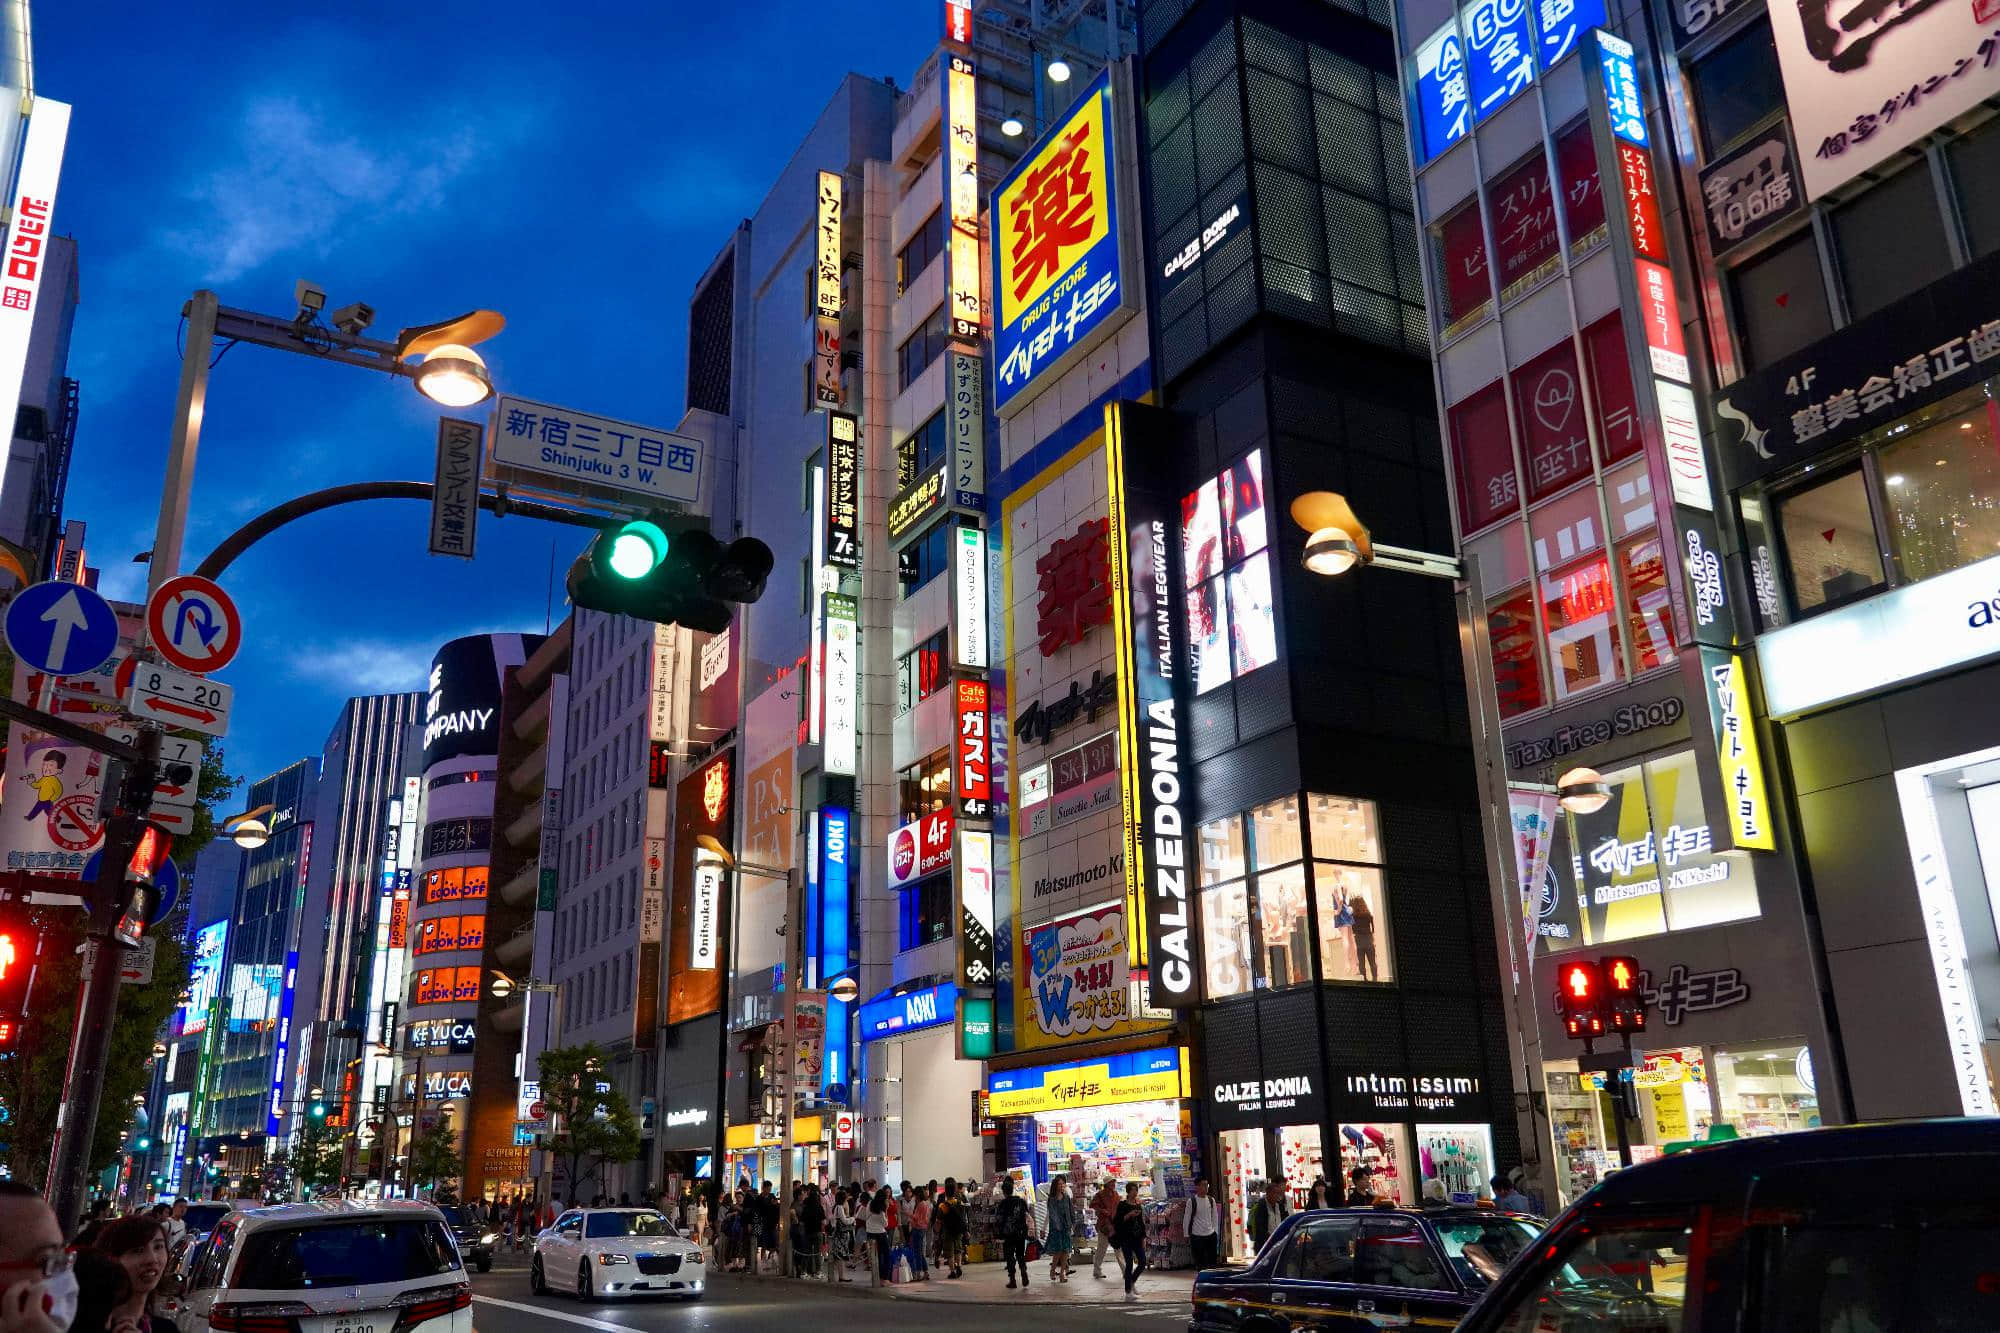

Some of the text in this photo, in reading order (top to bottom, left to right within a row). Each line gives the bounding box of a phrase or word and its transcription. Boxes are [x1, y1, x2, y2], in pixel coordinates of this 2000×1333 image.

[952, 58, 972, 74] 9F
[1636, 153, 1651, 196] スリム
[1011, 121, 1095, 303] 薬
[1621, 149, 1649, 252] ビューティハウス
[820, 293, 839, 305] 8F
[1021, 260, 1088, 333] DRUG STORE
[957, 321, 978, 336] 9F
[999, 271, 1117, 385] マツモトキヨシ
[1784, 366, 1816, 398] 4F
[506, 407, 697, 474] 新宿三丁目西
[956, 357, 973, 488] みずのクリニック
[540, 447, 657, 486] Shinjuku 3 W.
[961, 492, 979, 507] 8F
[834, 531, 854, 555] 7F
[1036, 516, 1113, 658] 薬
[1686, 529, 1714, 626] Tax Free
[1151, 520, 1173, 678] ITALIAN LEGWEAR
[959, 685, 985, 697] Café
[423, 707, 494, 751] OMPANY
[1507, 697, 1685, 769] Tax Free Shop
[962, 710, 985, 790] ガスト
[1711, 663, 1759, 839] マツモトキヨシ
[964, 799, 985, 815] 4F
[432, 839, 476, 852] コンタクト
[827, 820, 845, 863] AOKI
[927, 816, 948, 846] 4F
[1149, 699, 1192, 993] CALZEDONIA
[1034, 864, 1107, 899] Matsumoto
[700, 901, 711, 957] Onitsuka
[965, 911, 986, 937] SHIN
[965, 927, 987, 951] JUKU
[906, 993, 936, 1025] AOKI
[1038, 974, 1073, 1029] W
[1072, 987, 1127, 1020] つかえる!
[1051, 1080, 1102, 1103] マツモトキヨシ
[1214, 1075, 1312, 1103] CALZE DONIA
[1374, 1096, 1456, 1111] Italian lingerie
